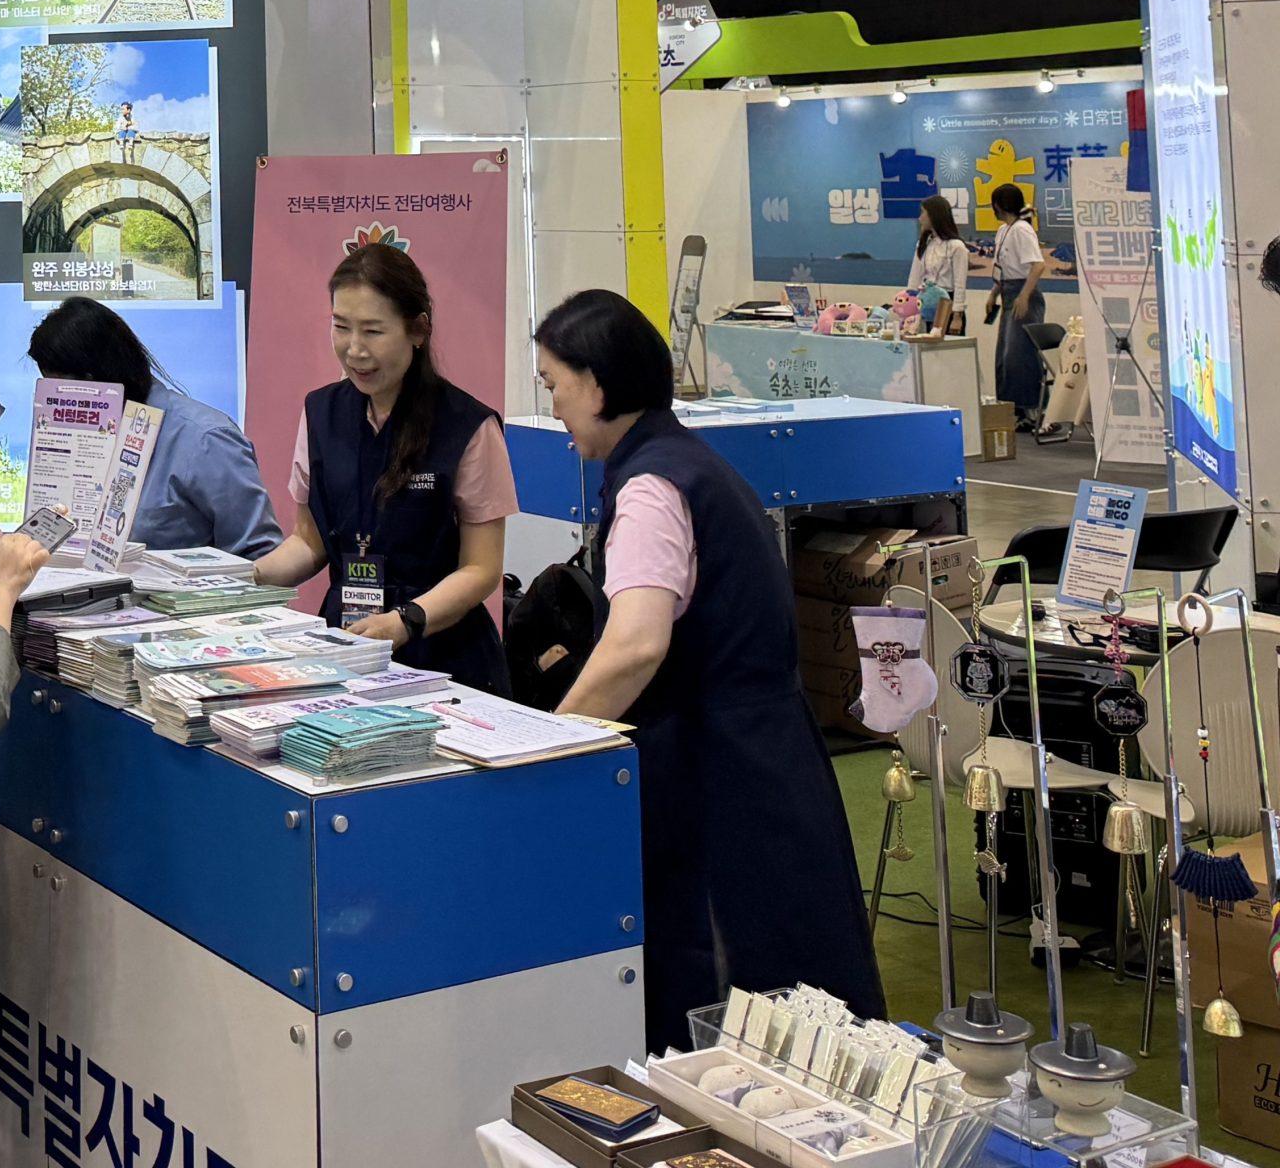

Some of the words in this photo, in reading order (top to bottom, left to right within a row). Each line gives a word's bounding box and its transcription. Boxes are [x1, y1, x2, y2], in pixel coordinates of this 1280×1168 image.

[941, 119, 962, 128] Little
[1083, 109, 1127, 127] 日常甘
[287, 194, 391, 214] 전북특별자치도
[394, 193, 472, 213] 전담여행사
[828, 187, 880, 225] 일상
[32, 261, 58, 277] 완주
[62, 261, 114, 278] 위봉산성
[769, 372, 799, 397] 속초는
[804, 375, 832, 398] 필수
[347, 562, 377, 578] KITS
[343, 589, 382, 602] EXHIBITOR
